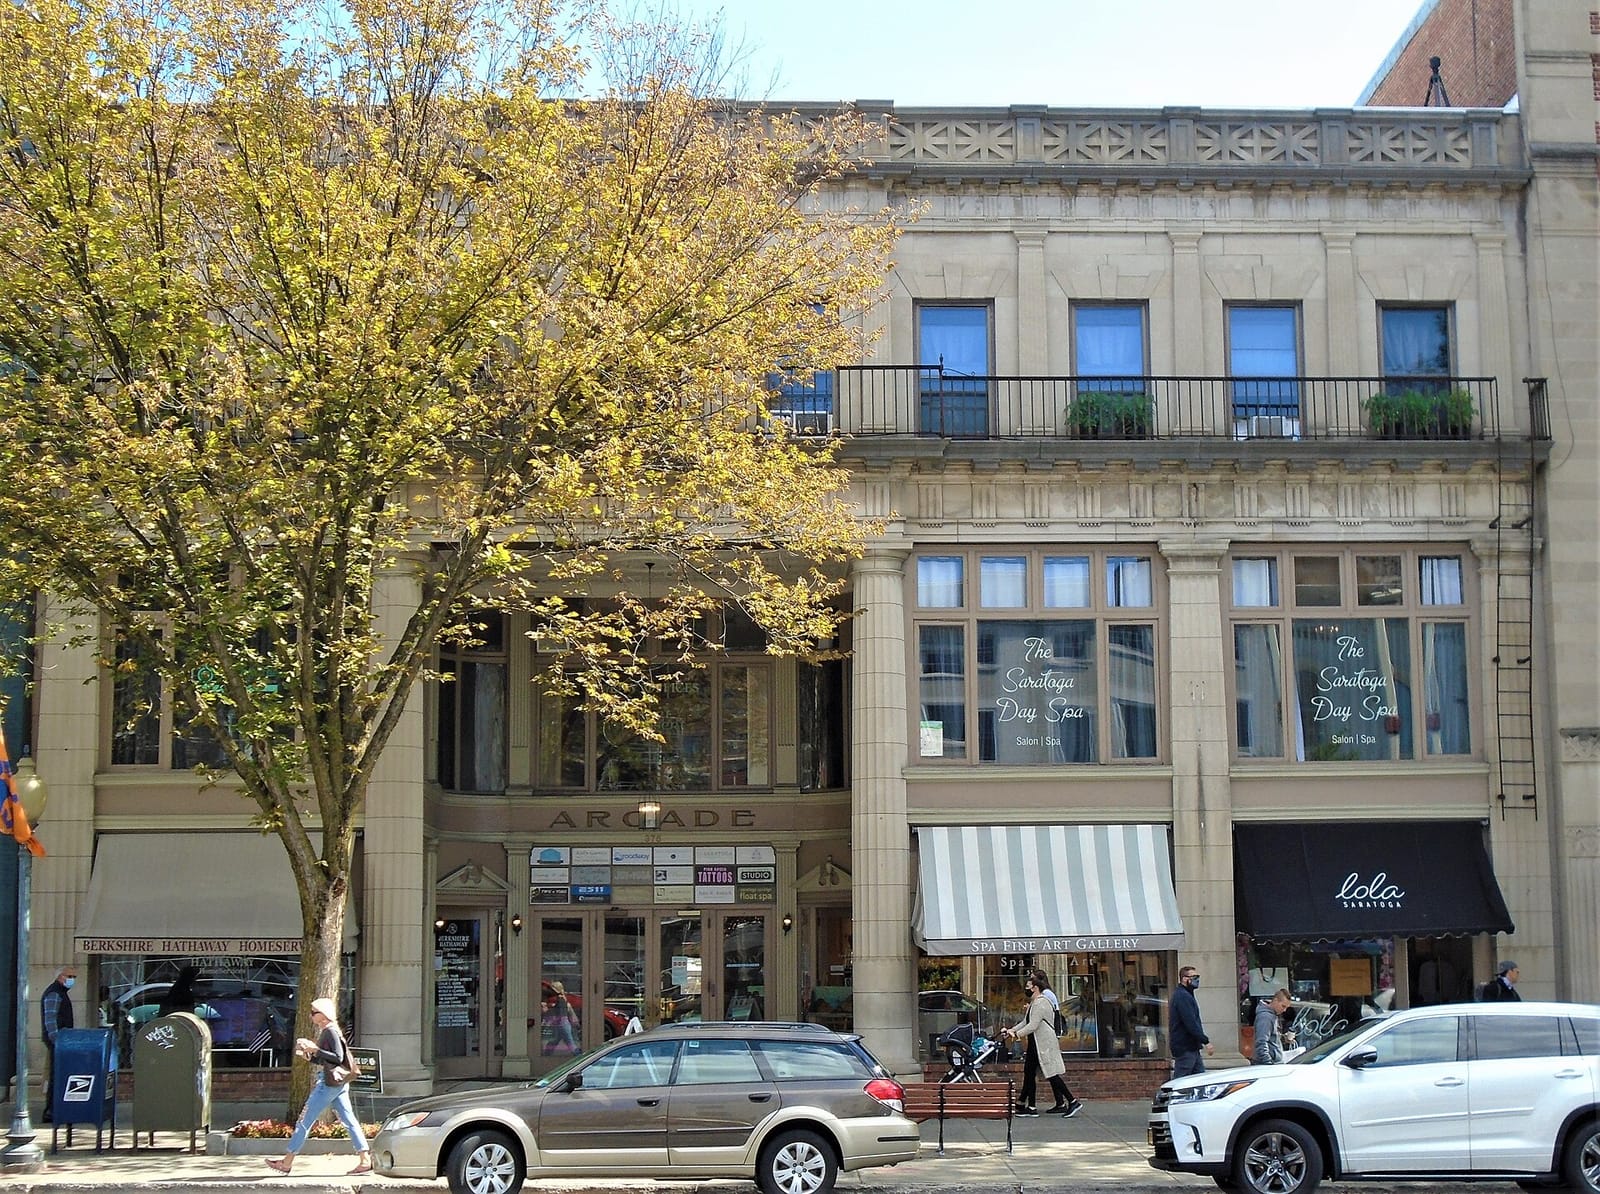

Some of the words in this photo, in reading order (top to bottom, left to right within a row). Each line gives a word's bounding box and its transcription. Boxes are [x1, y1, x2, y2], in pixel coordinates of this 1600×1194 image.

[1024, 637, 1052, 662] The
[1336, 636, 1365, 661] The
[1002, 667, 1074, 693] Saratoga
[1316, 666, 1387, 692] Saratoga
[996, 697, 1037, 723] Day
[1045, 697, 1083, 723] Spa
[1311, 696, 1352, 722] Day
[1359, 695, 1398, 721] Spa
[1016, 736, 1039, 746] Salon
[1045, 736, 1061, 747] Spa
[1332, 734, 1354, 744] Salon
[1361, 734, 1376, 745] Spa
[550, 809, 756, 828] ARCADE
[697, 871, 733, 883] TATTOOS
[742, 871, 770, 879] STUDIO
[1335, 872, 1405, 900] lola
[739, 891, 757, 900] float
[758, 893, 772, 901] spa
[83, 940, 154, 951] BERKSHIRE
[162, 940, 231, 952] HATHAWAY
[971, 941, 997, 953] SPA
[1003, 940, 1037, 951] FINE
[1042, 939, 1071, 950] ART
[1075, 938, 1140, 950] GALLERY
[191, 957, 254, 967] HATHAWAY
[1000, 957, 1025, 969] Spa
